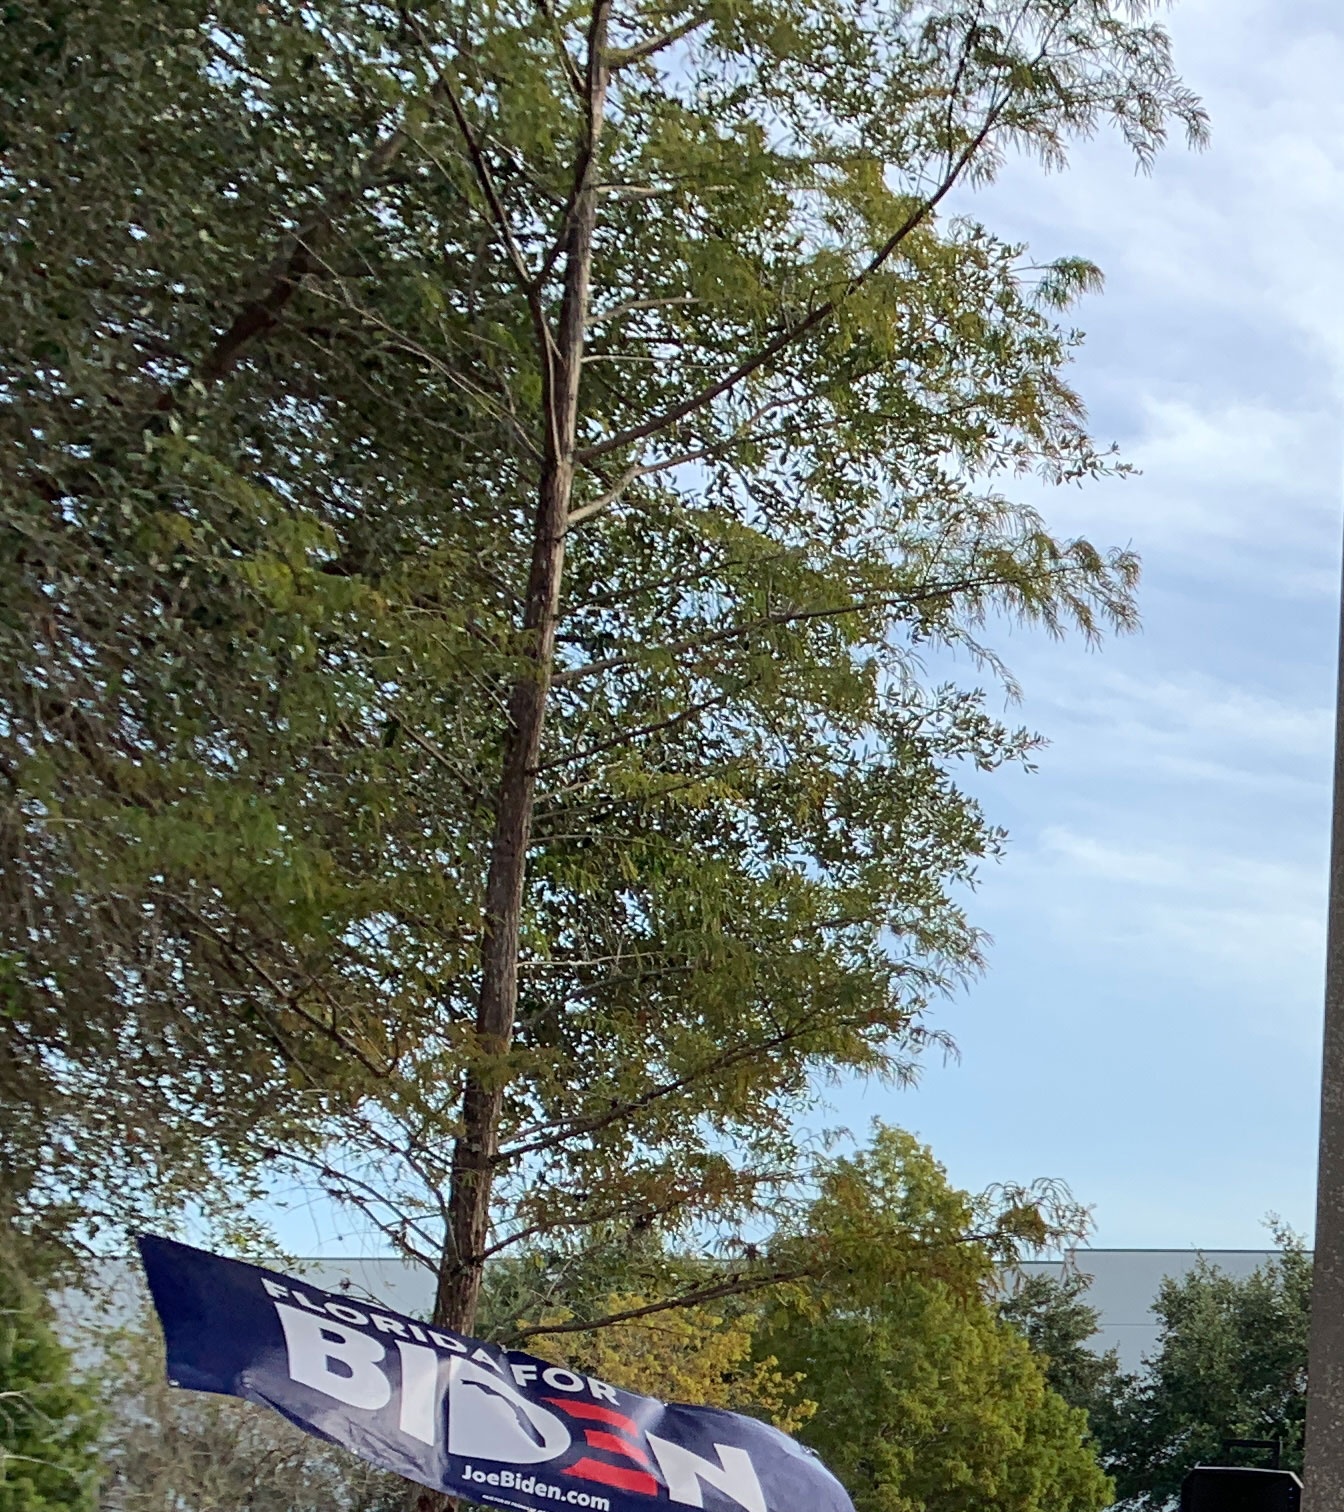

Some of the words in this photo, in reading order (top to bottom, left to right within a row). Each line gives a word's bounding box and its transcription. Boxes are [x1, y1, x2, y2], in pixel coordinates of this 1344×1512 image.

[261, 1278, 504, 1374] FLORIDA
[511, 1363, 621, 1407] FOR
[462, 1465, 611, 1512] JoeBiden.com
